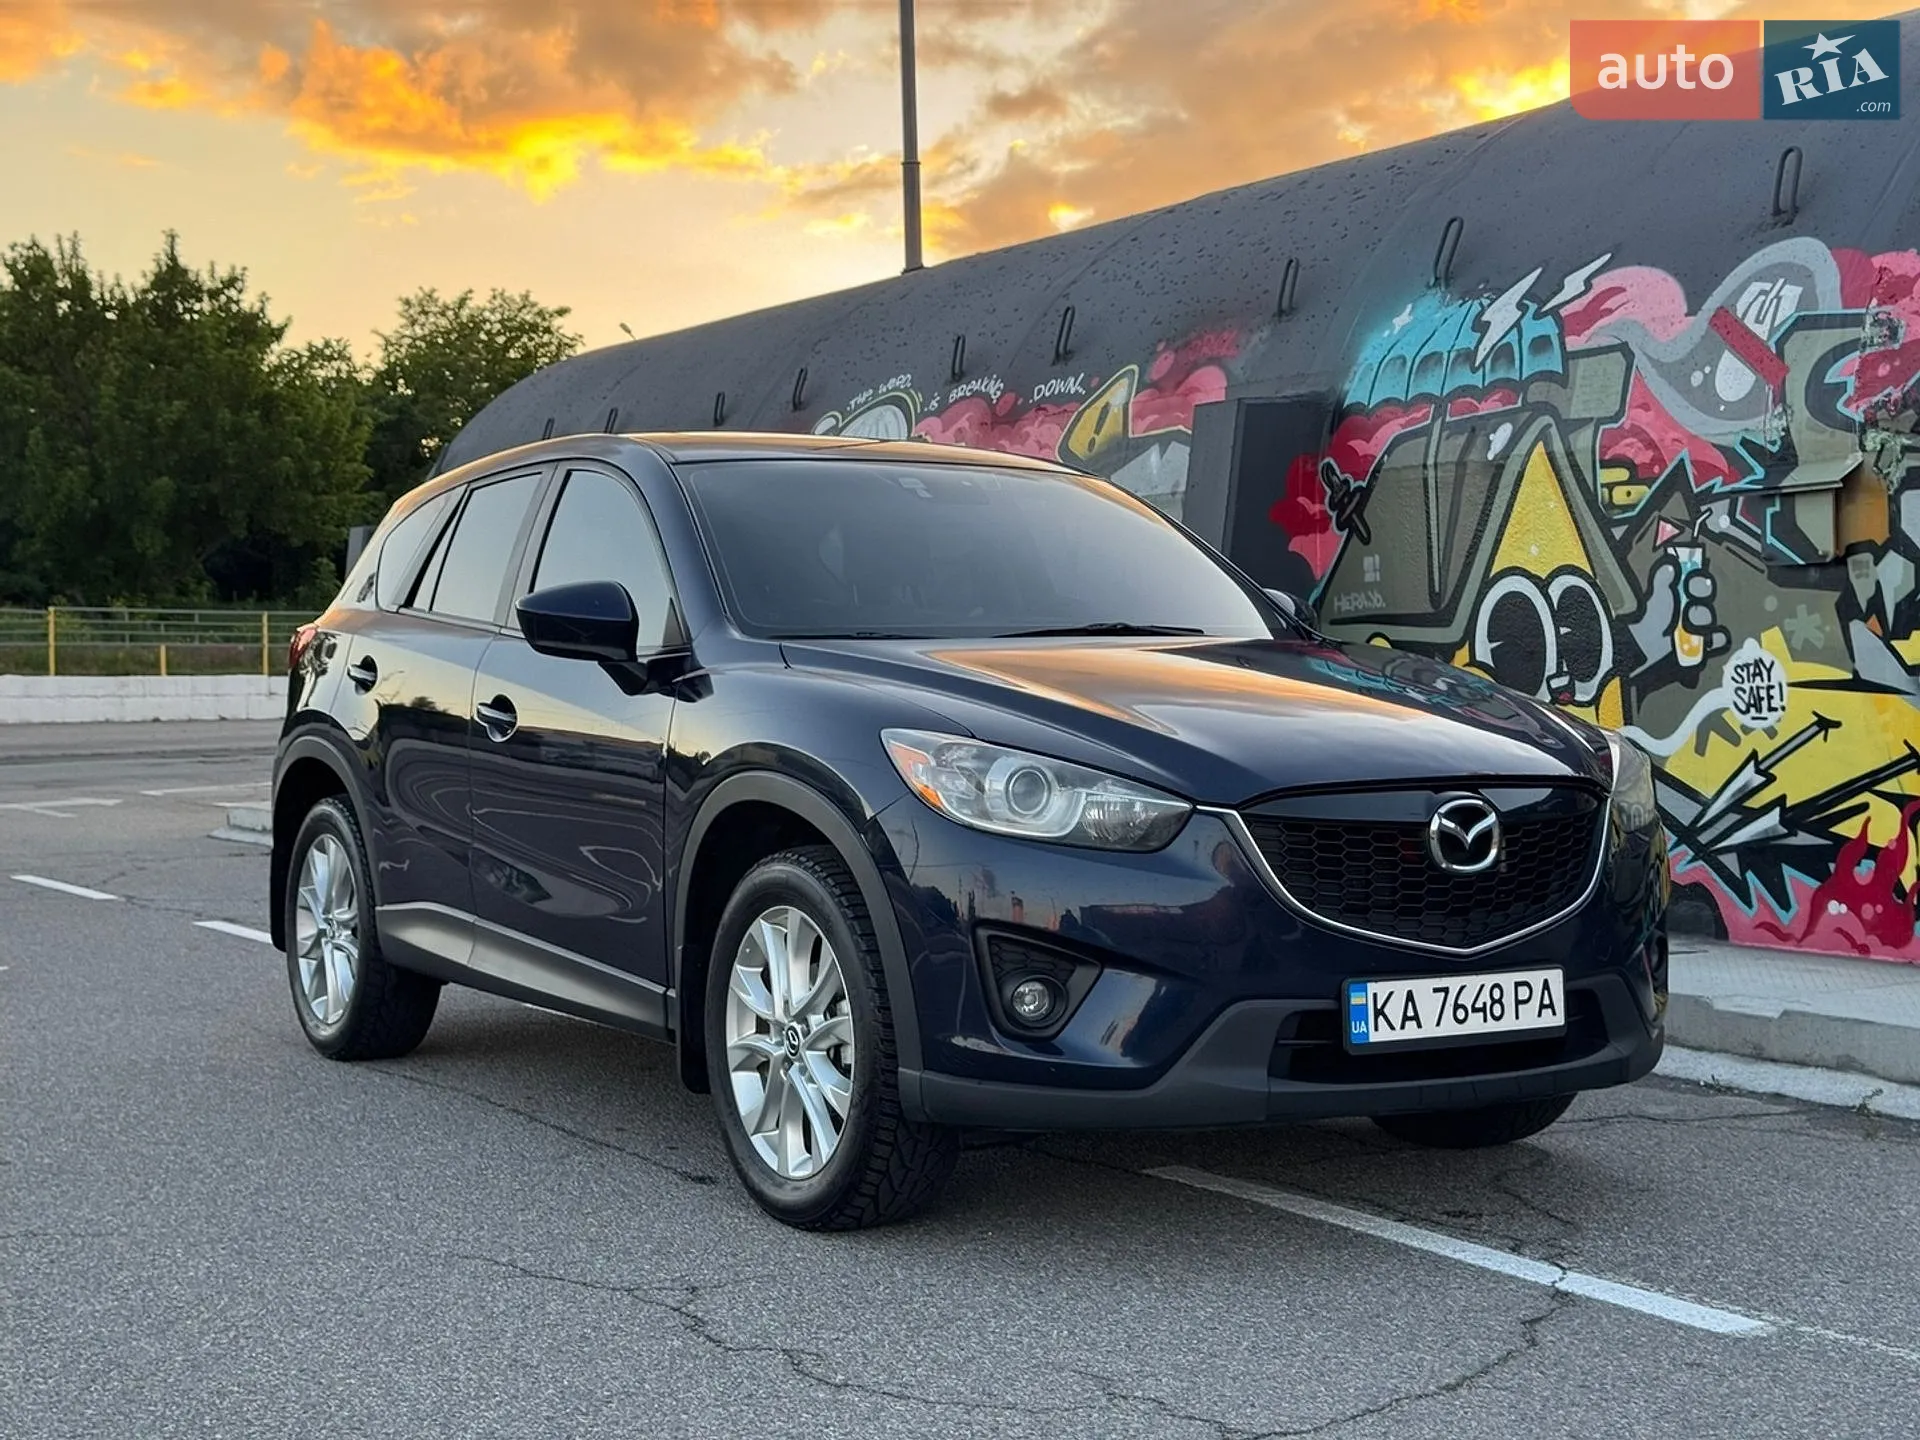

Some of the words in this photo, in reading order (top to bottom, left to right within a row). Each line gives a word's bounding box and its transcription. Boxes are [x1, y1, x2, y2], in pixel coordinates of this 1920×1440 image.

[1730, 656, 1775, 685] STAY
[1732, 681, 1786, 716] SAFE!
[1372, 989, 1423, 1032] KA
[1431, 982, 1506, 1027] 7648
[1513, 977, 1558, 1021] PA
[1351, 1020, 1368, 1034] UA
